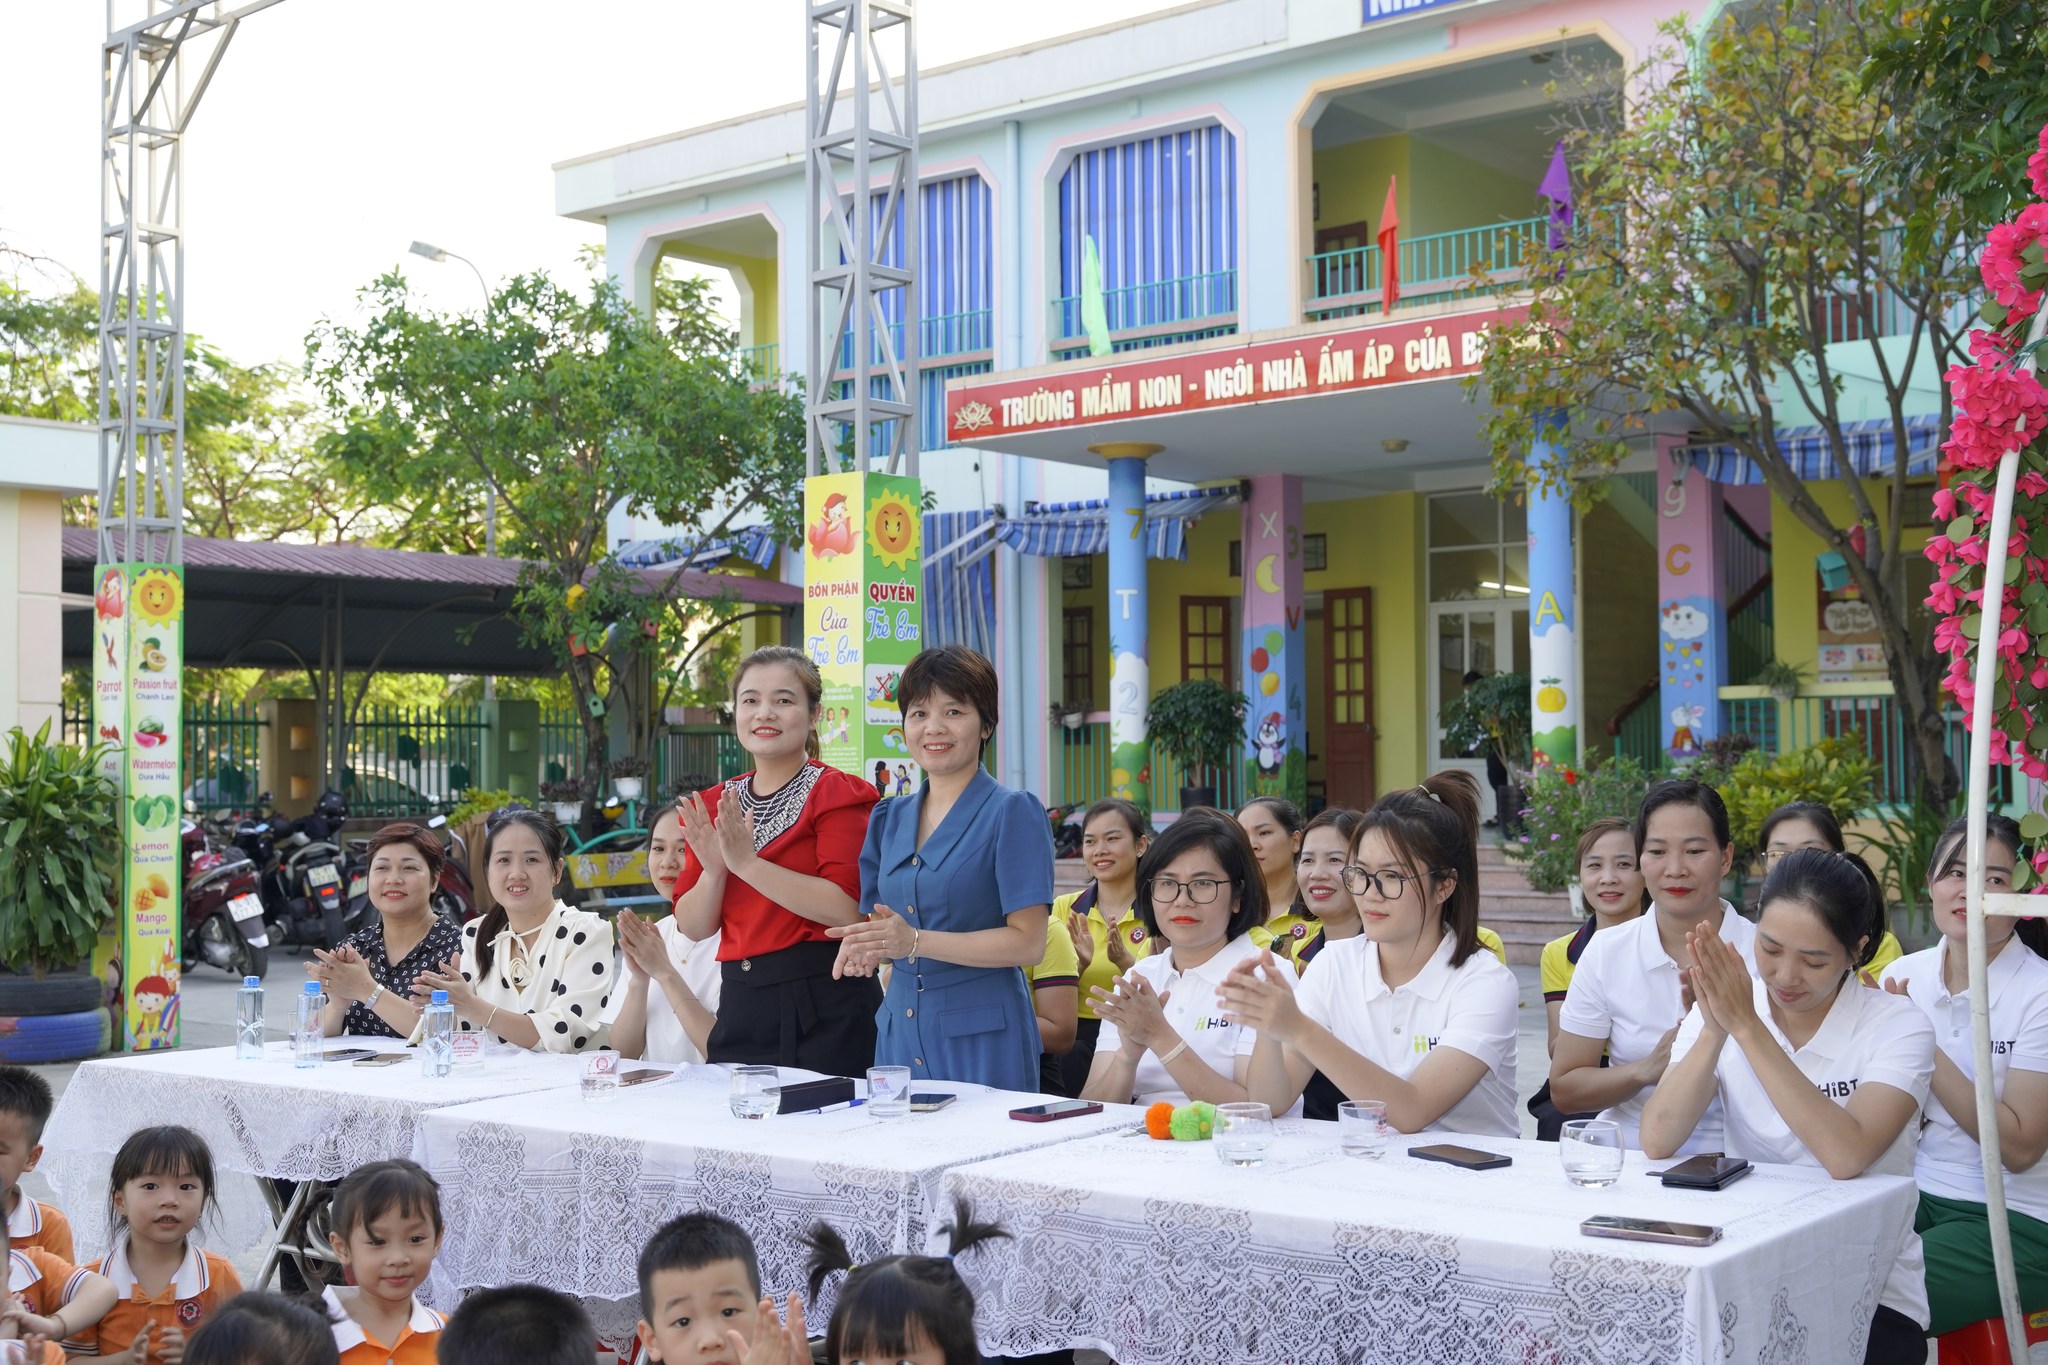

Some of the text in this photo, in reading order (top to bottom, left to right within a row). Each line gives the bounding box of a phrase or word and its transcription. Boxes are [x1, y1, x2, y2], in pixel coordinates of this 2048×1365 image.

[1000, 386, 1075, 428] TRƯỜNG
[1081, 372, 1132, 418] MẦM
[1138, 374, 1182, 410] NON
[1204, 357, 1254, 401] NGÔI
[1262, 349, 1308, 393] NHÀ
[1317, 338, 1355, 386] ẤM
[1362, 338, 1395, 380] ÁP
[1404, 325, 1453, 374] CỦA
[1125, 509, 1144, 539] 7
[1259, 511, 1278, 539] X
[1286, 524, 1299, 560] 3
[1665, 544, 1691, 576] C
[1114, 588, 1138, 620] T
[1286, 605, 1300, 632] V
[1535, 590, 1564, 625] A
[895, 609, 919, 641] Em
[836, 634, 860, 665] Em
[96, 680, 122, 692] Parrot
[133, 678, 177, 690] Passion fruit
[1118, 681, 1139, 715] 2
[132, 759, 177, 770] Watermelon
[135, 842, 169, 851] Lemon
[136, 913, 167, 925] Mango
